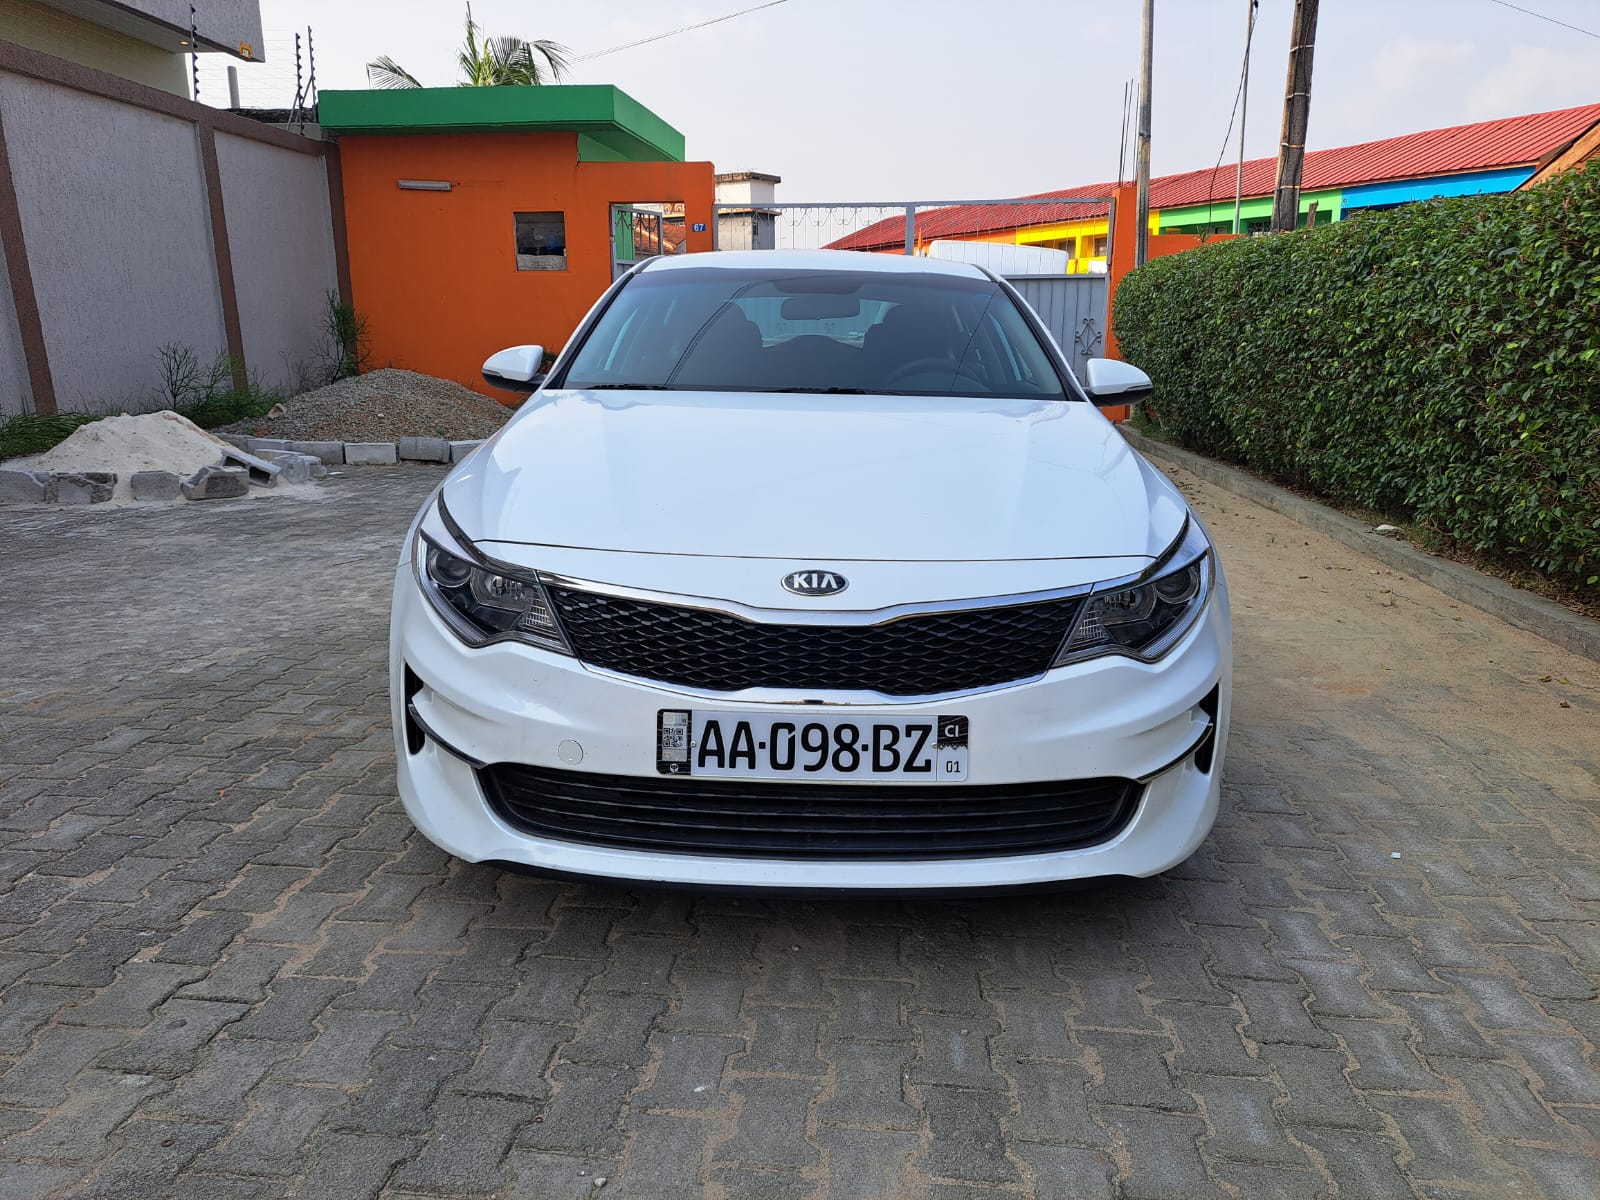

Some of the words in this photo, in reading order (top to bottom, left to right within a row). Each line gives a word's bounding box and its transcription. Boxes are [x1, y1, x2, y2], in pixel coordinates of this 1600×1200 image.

[693, 223, 704, 232] 67
[793, 573, 838, 589] KIA
[944, 724, 959, 738] CI
[946, 760, 960, 773] 01
